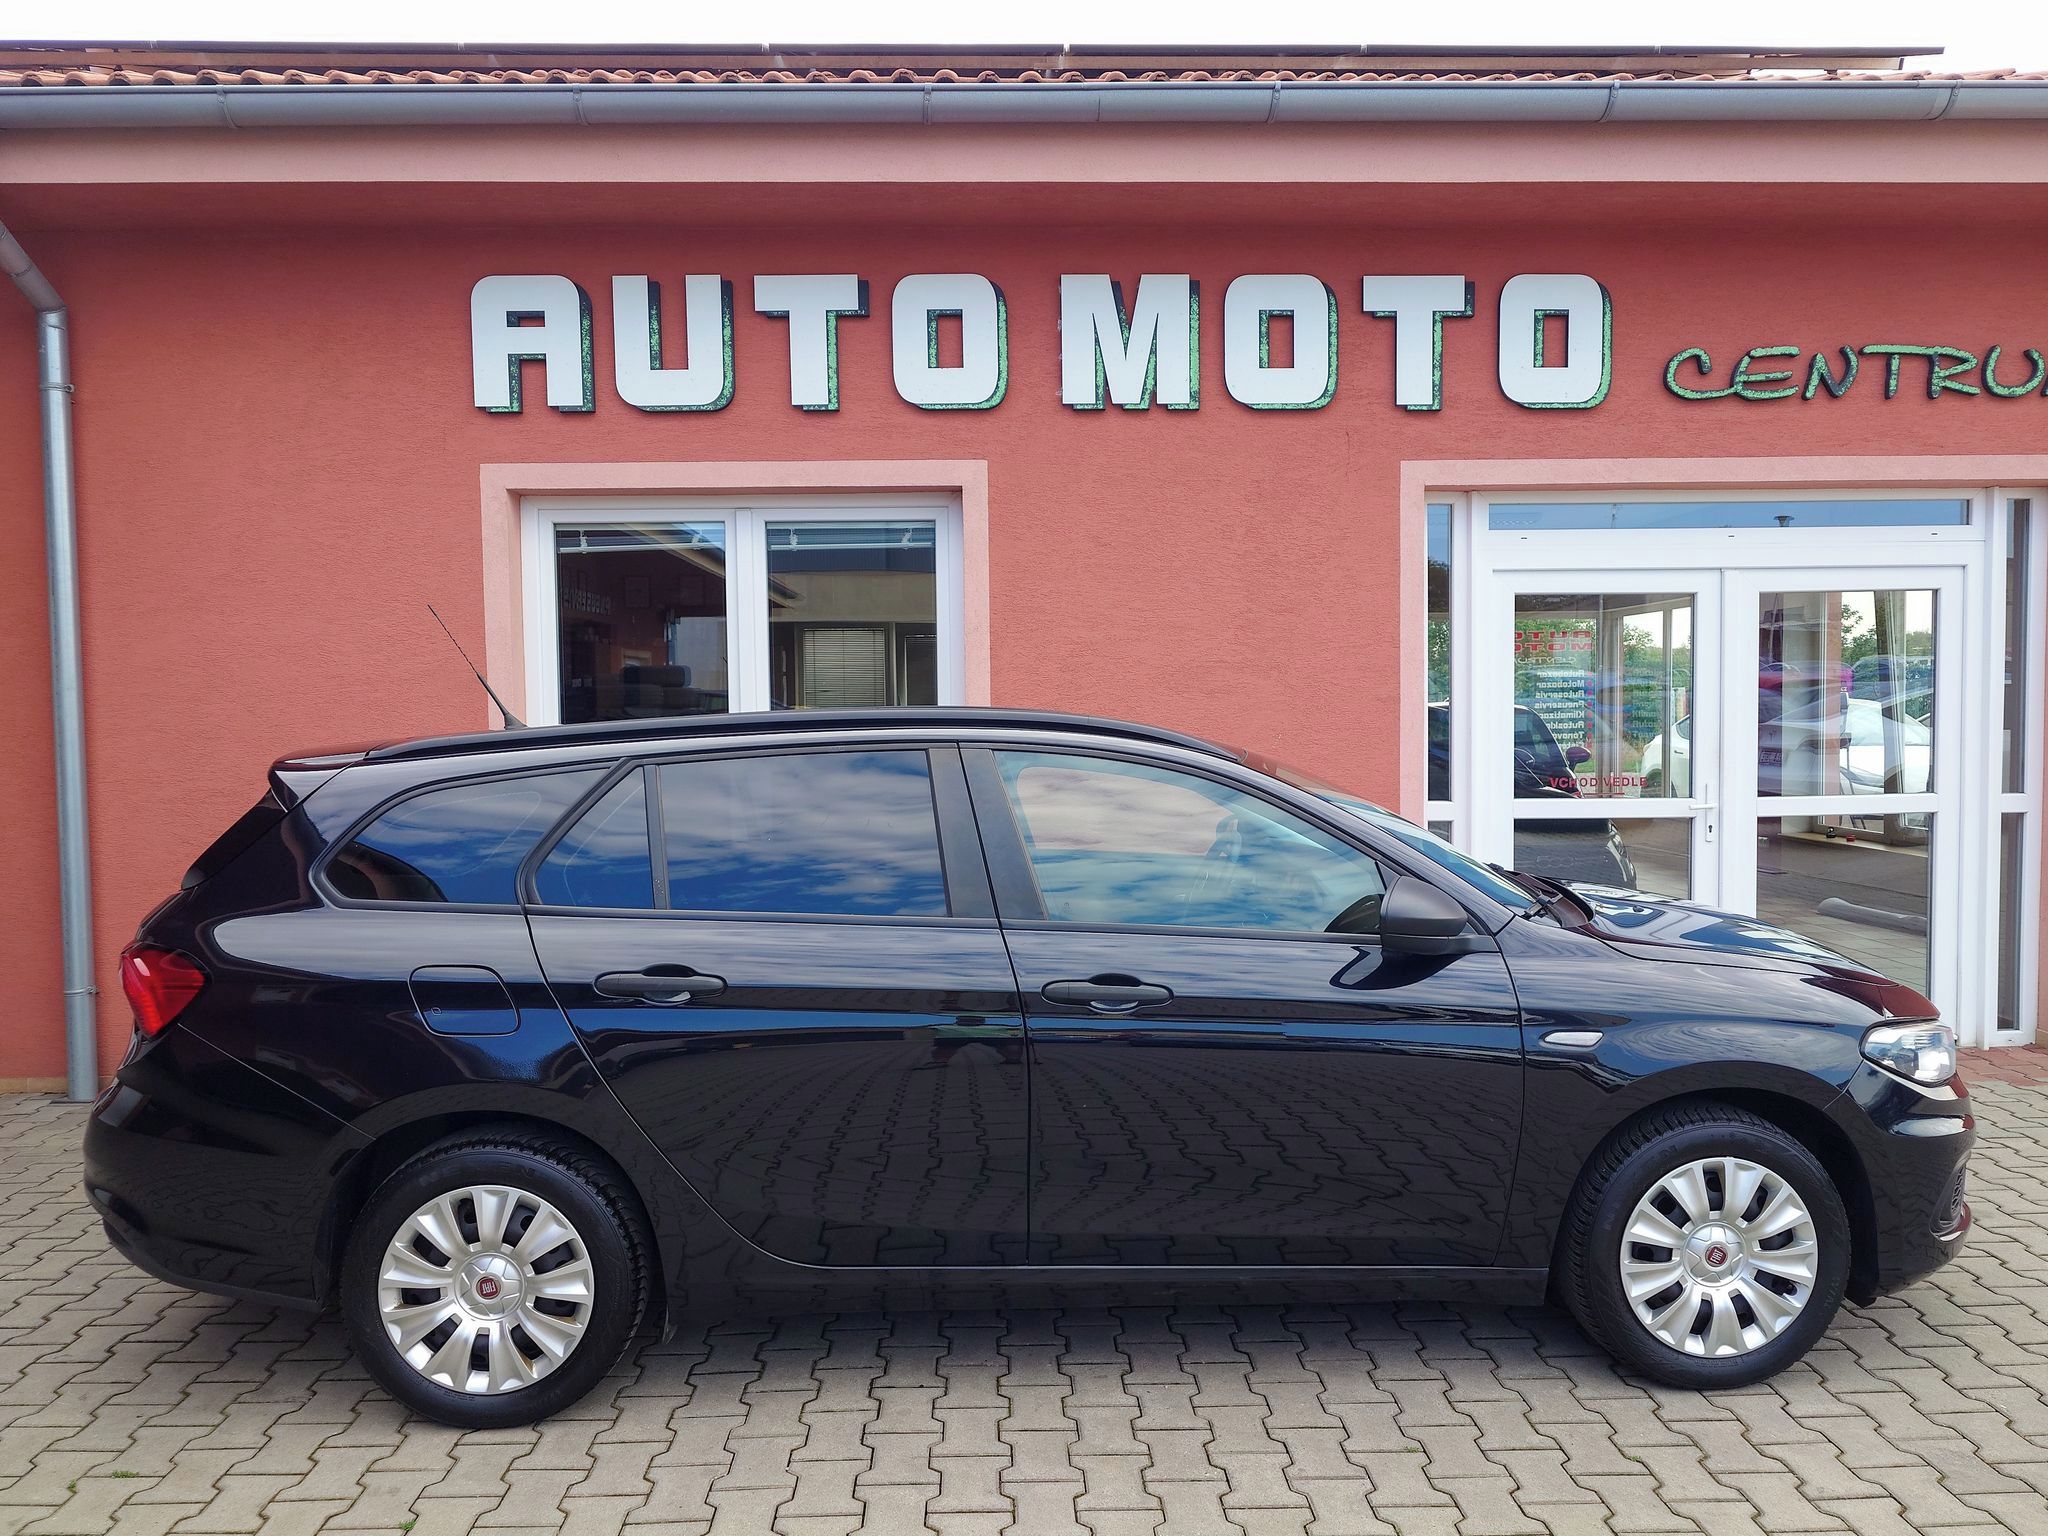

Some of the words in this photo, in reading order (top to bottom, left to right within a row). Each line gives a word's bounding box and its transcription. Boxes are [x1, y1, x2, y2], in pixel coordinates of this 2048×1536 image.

[471, 273, 1009, 413] AUTO
[1060, 273, 1613, 410] MOTO
[1663, 344, 2048, 400] CENTRU
[1549, 777, 1598, 788] VCHOD
[1603, 776, 1648, 788] VEDLE
